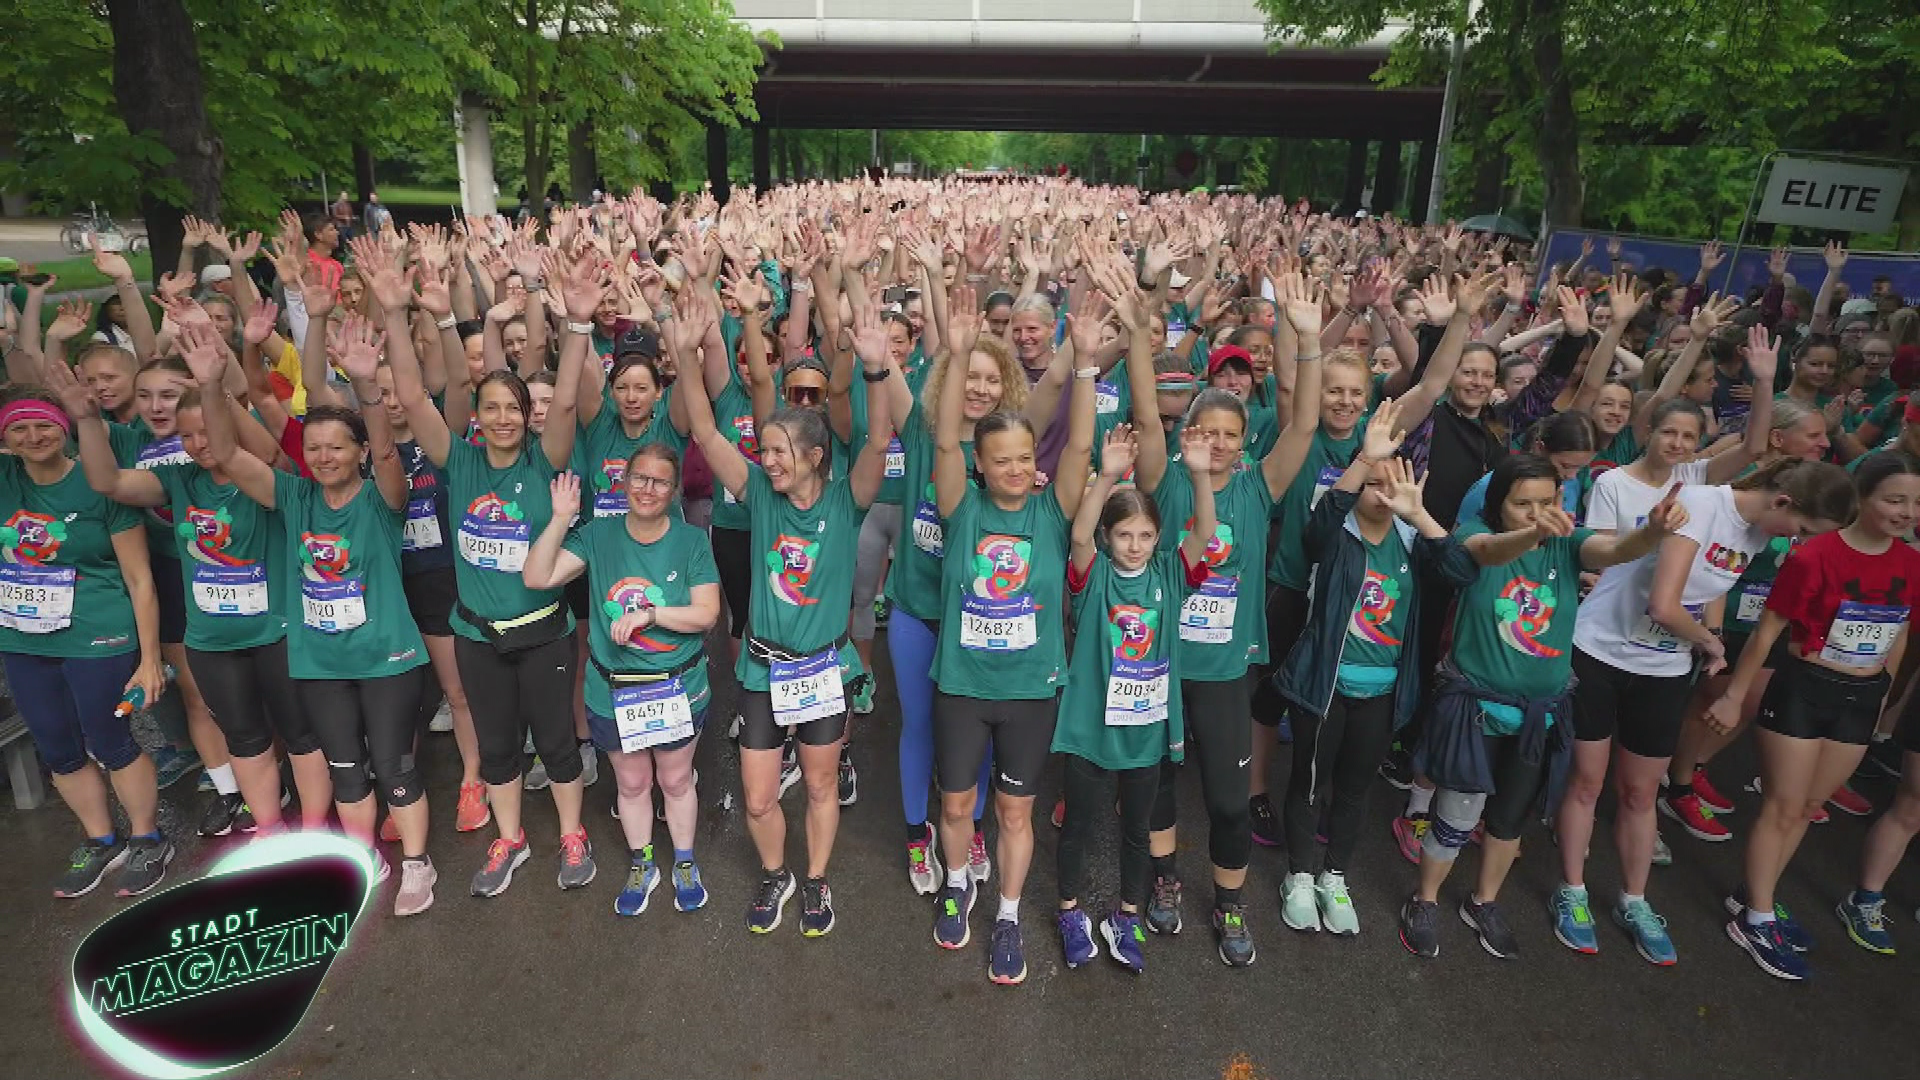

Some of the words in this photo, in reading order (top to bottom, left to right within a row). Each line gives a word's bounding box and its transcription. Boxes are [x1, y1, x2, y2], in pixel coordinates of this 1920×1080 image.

[1781, 179, 1881, 213] ELITE
[919, 524, 943, 542] 106
[465, 536, 504, 556] 12051
[0, 584, 46, 603] 12583
[206, 586, 236, 600] 9121
[970, 616, 1014, 636] 12682
[1843, 624, 1883, 640] 5973
[781, 679, 819, 699] 9354
[626, 702, 664, 721] 8457
